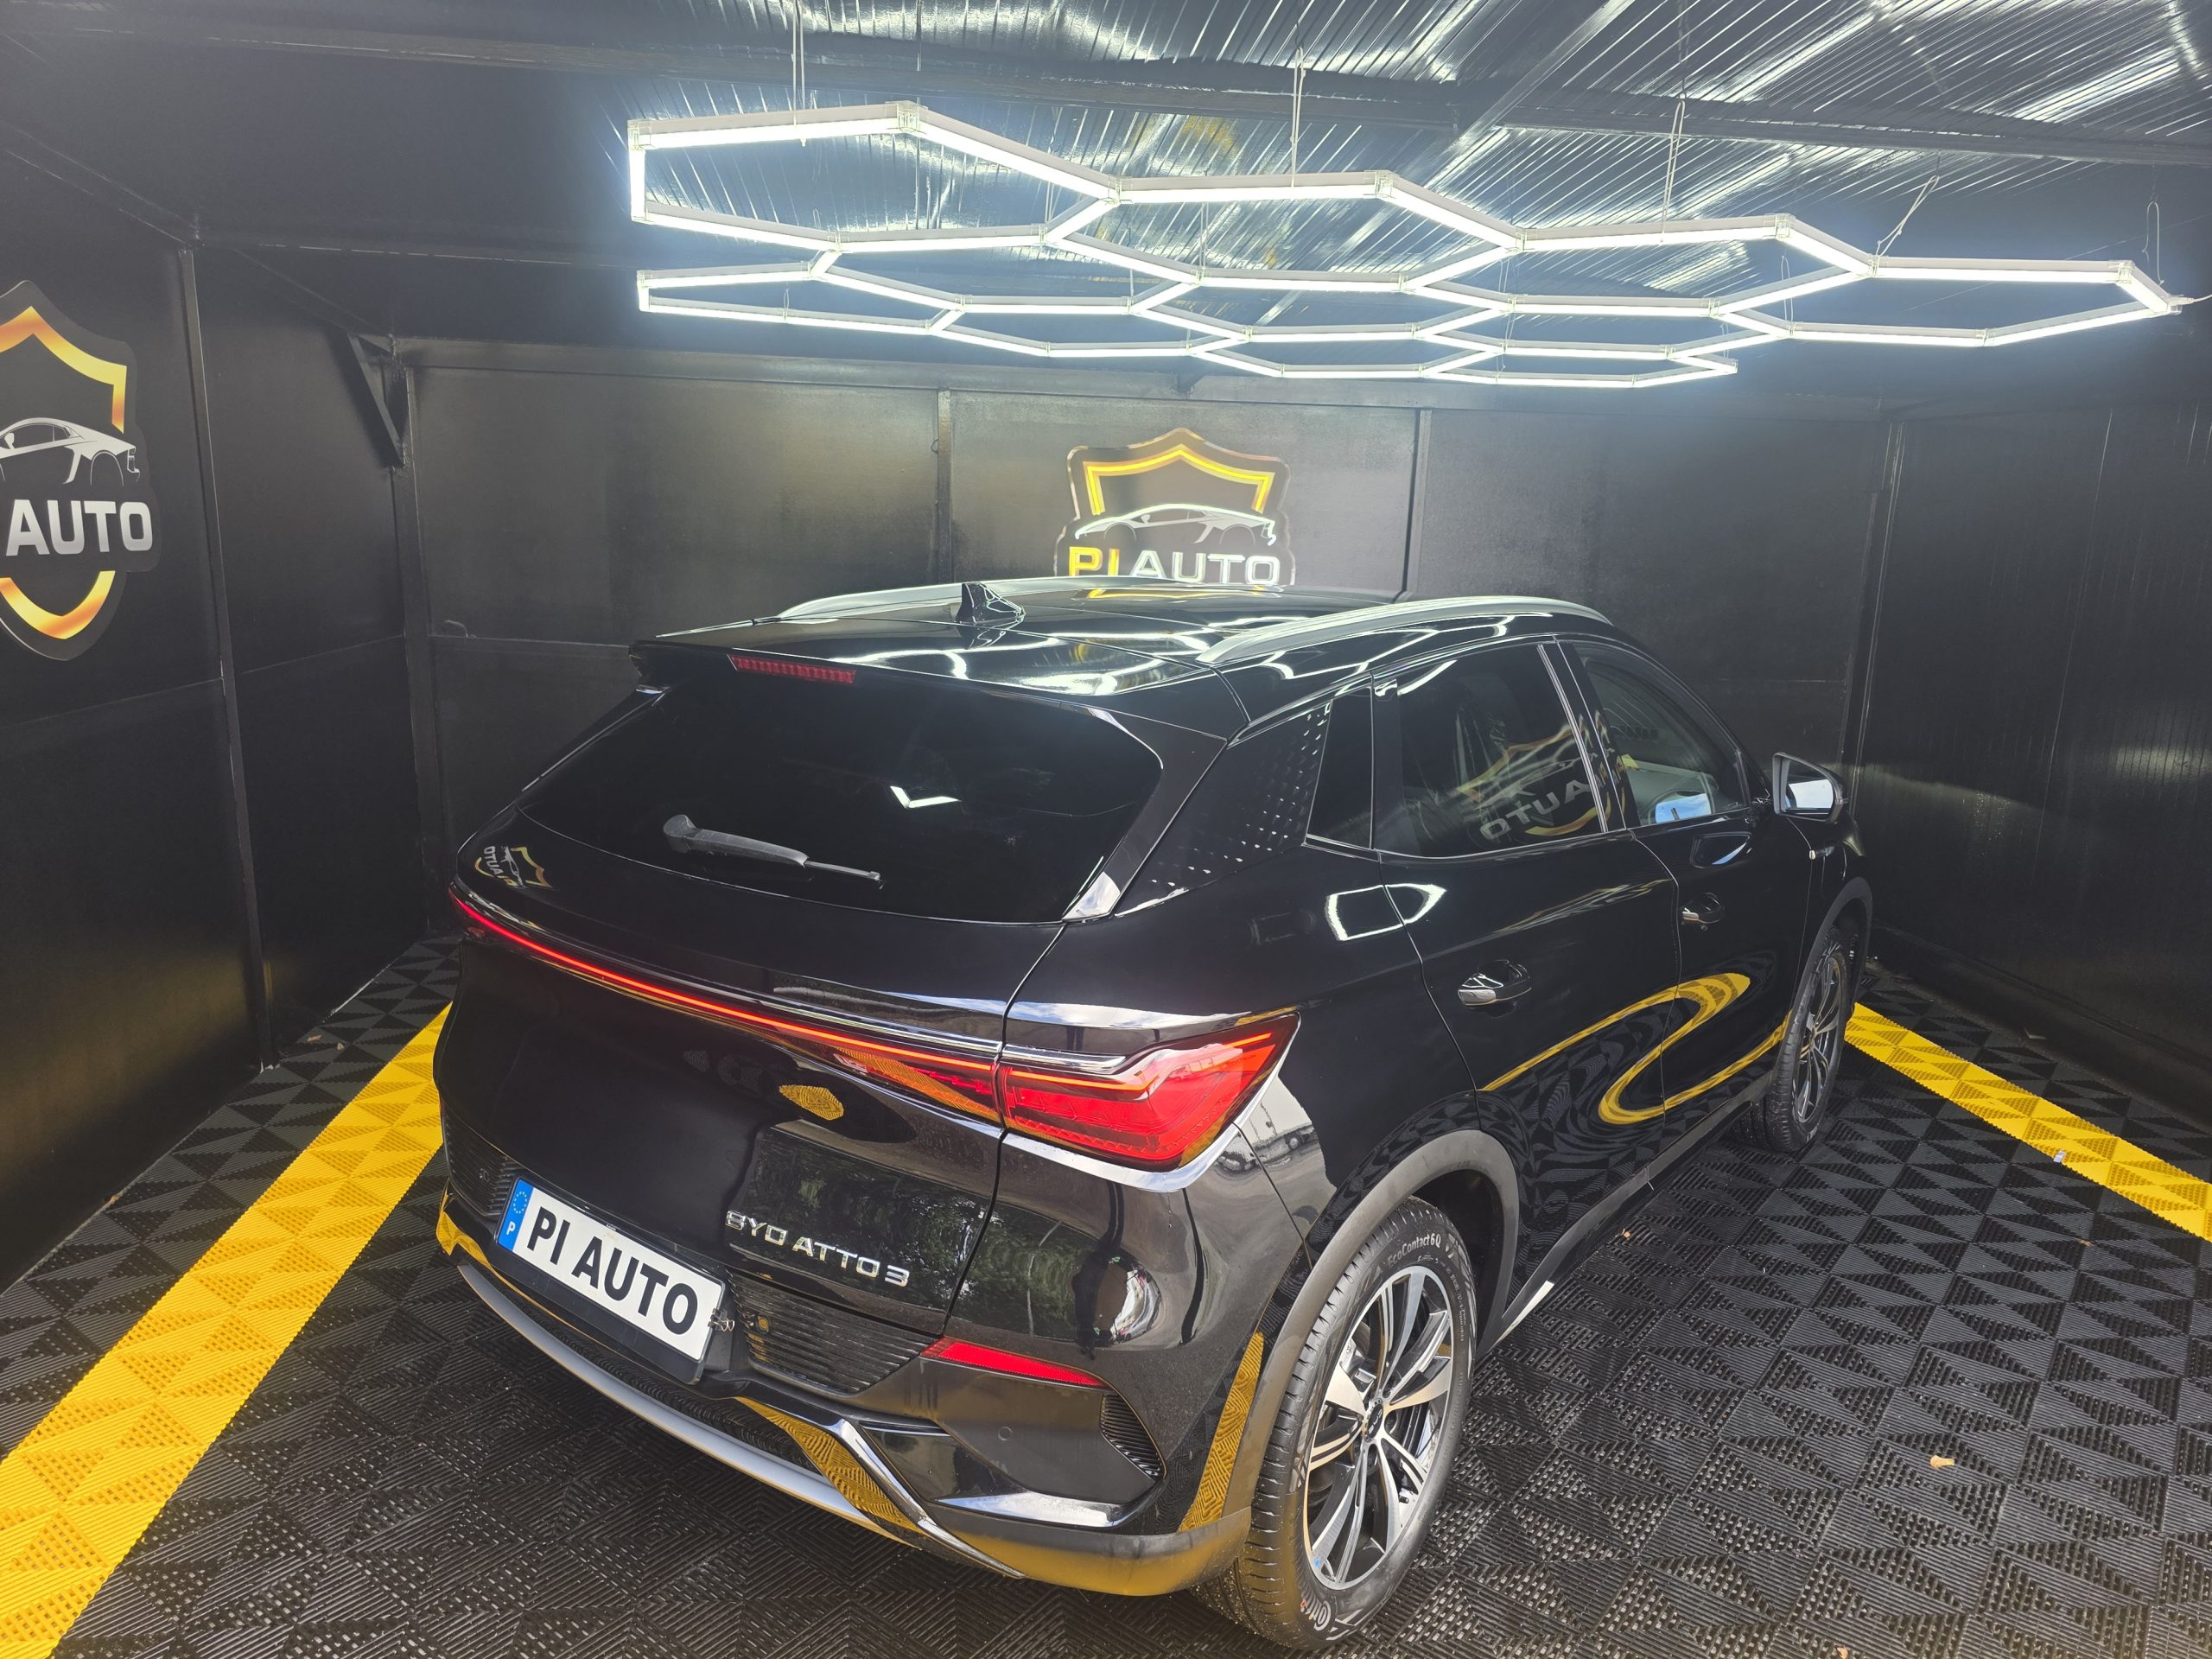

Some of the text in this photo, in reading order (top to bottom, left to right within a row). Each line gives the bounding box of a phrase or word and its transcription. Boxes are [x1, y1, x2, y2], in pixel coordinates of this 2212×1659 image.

[6, 499, 153, 556] AUTO
[1069, 546, 1281, 585] PI AUTO
[505, 1221, 516, 1236] P
[725, 1210, 788, 1246] BYD
[792, 1236, 880, 1278] ATTO
[526, 1206, 698, 1335] PI AUTO
